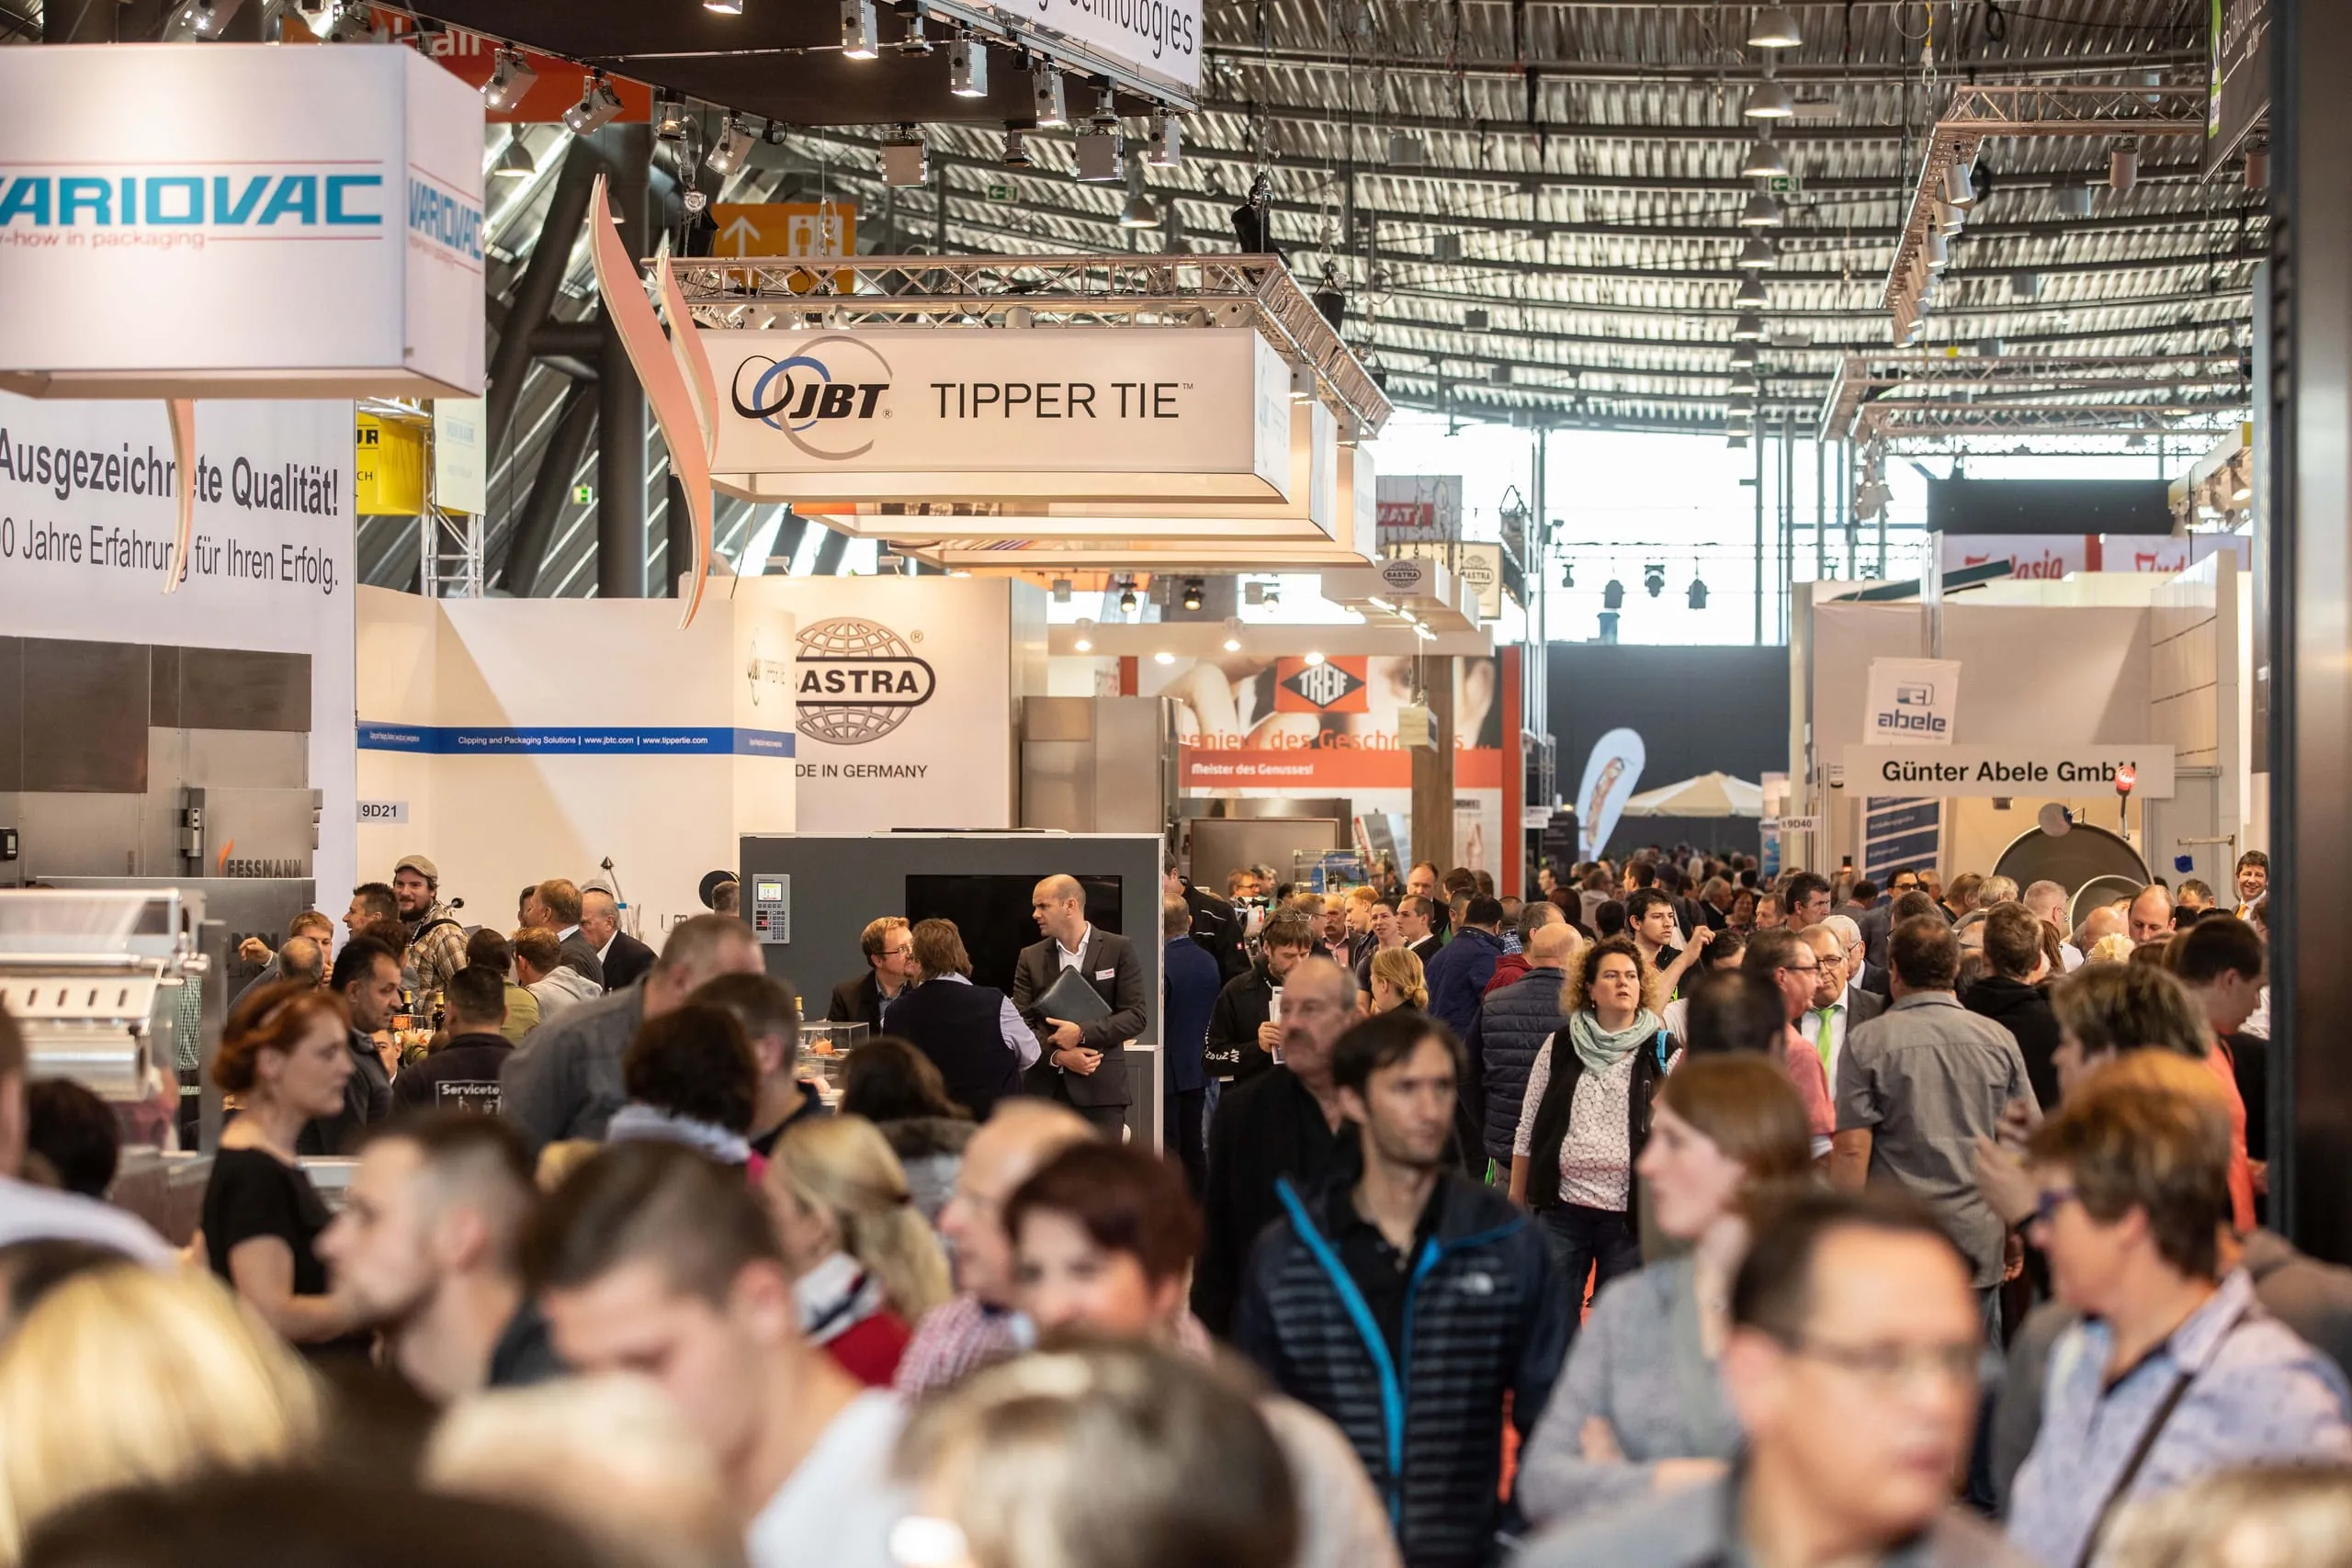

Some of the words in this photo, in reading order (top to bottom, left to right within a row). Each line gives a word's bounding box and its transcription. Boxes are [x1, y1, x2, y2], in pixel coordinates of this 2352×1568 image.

[0, 175, 383, 226] ARIOVAC
[409, 177, 482, 261] VARIOVAC
[67, 231, 85, 246] in
[92, 231, 205, 250] packaging
[931, 382, 1097, 418] TIPPER
[232, 457, 338, 516] Qualität!
[23, 519, 83, 563] Jahre
[195, 536, 221, 575] für
[228, 538, 274, 580] Ihren
[281, 544, 339, 595] Erfolg.
[796, 670, 919, 694] ASTRA
[1298, 662, 1348, 707] TREIF
[1878, 709, 1946, 732] abele
[458, 736, 488, 745] Clipping
[489, 736, 503, 744] and
[504, 736, 542, 745] Packaging
[543, 736, 576, 744] Solutions
[584, 736, 634, 745] www.jbtc.com
[642, 736, 708, 745] www.tippertie.com
[1271, 729, 1311, 750] des
[822, 764, 838, 778] IN
[843, 764, 928, 778] GERMANY
[1192, 764, 1234, 775] Meister
[1236, 764, 1256, 774] des
[1258, 764, 1314, 775] Genusses!
[1883, 761, 1969, 782] Günter
[1976, 761, 2048, 782] Abele
[362, 805, 398, 817] 9D21
[1787, 819, 1813, 829] 9D40
[228, 860, 302, 878] FESSMANN
[442, 1084, 503, 1095] Servicete
